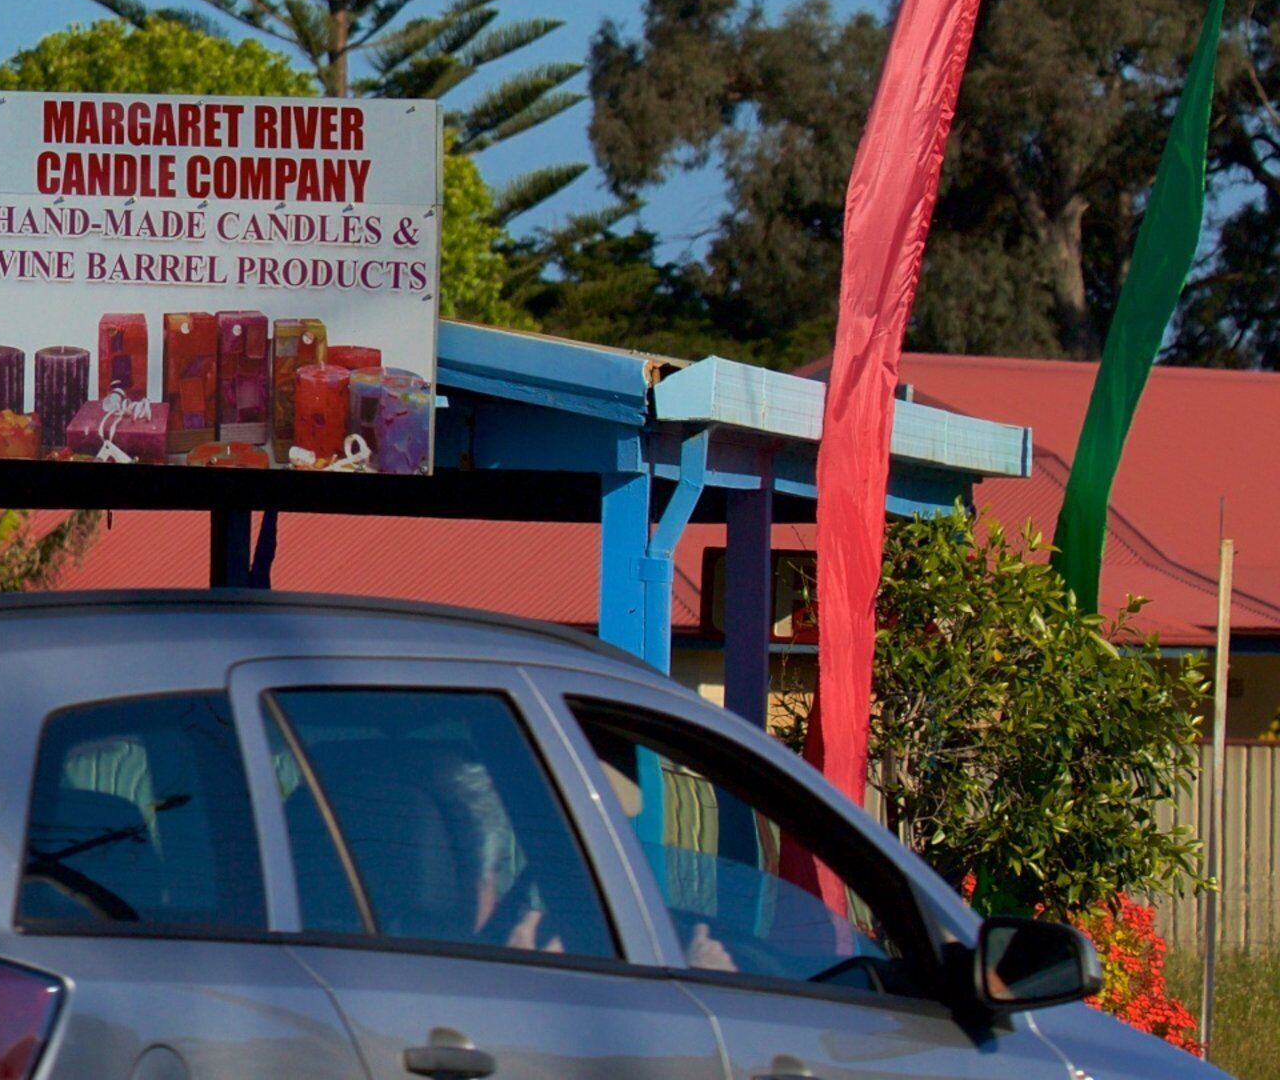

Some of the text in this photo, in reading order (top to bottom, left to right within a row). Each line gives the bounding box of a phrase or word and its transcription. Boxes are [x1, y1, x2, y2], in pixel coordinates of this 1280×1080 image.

[42, 100, 365, 151] MARGARET RIVER
[36, 151, 371, 203] CANDLE COMPANY
[216, 211, 382, 246] CANDLES
[392, 216, 421, 247] &
[86, 252, 229, 285] BARREL
[236, 256, 428, 291] PRODUCTS
